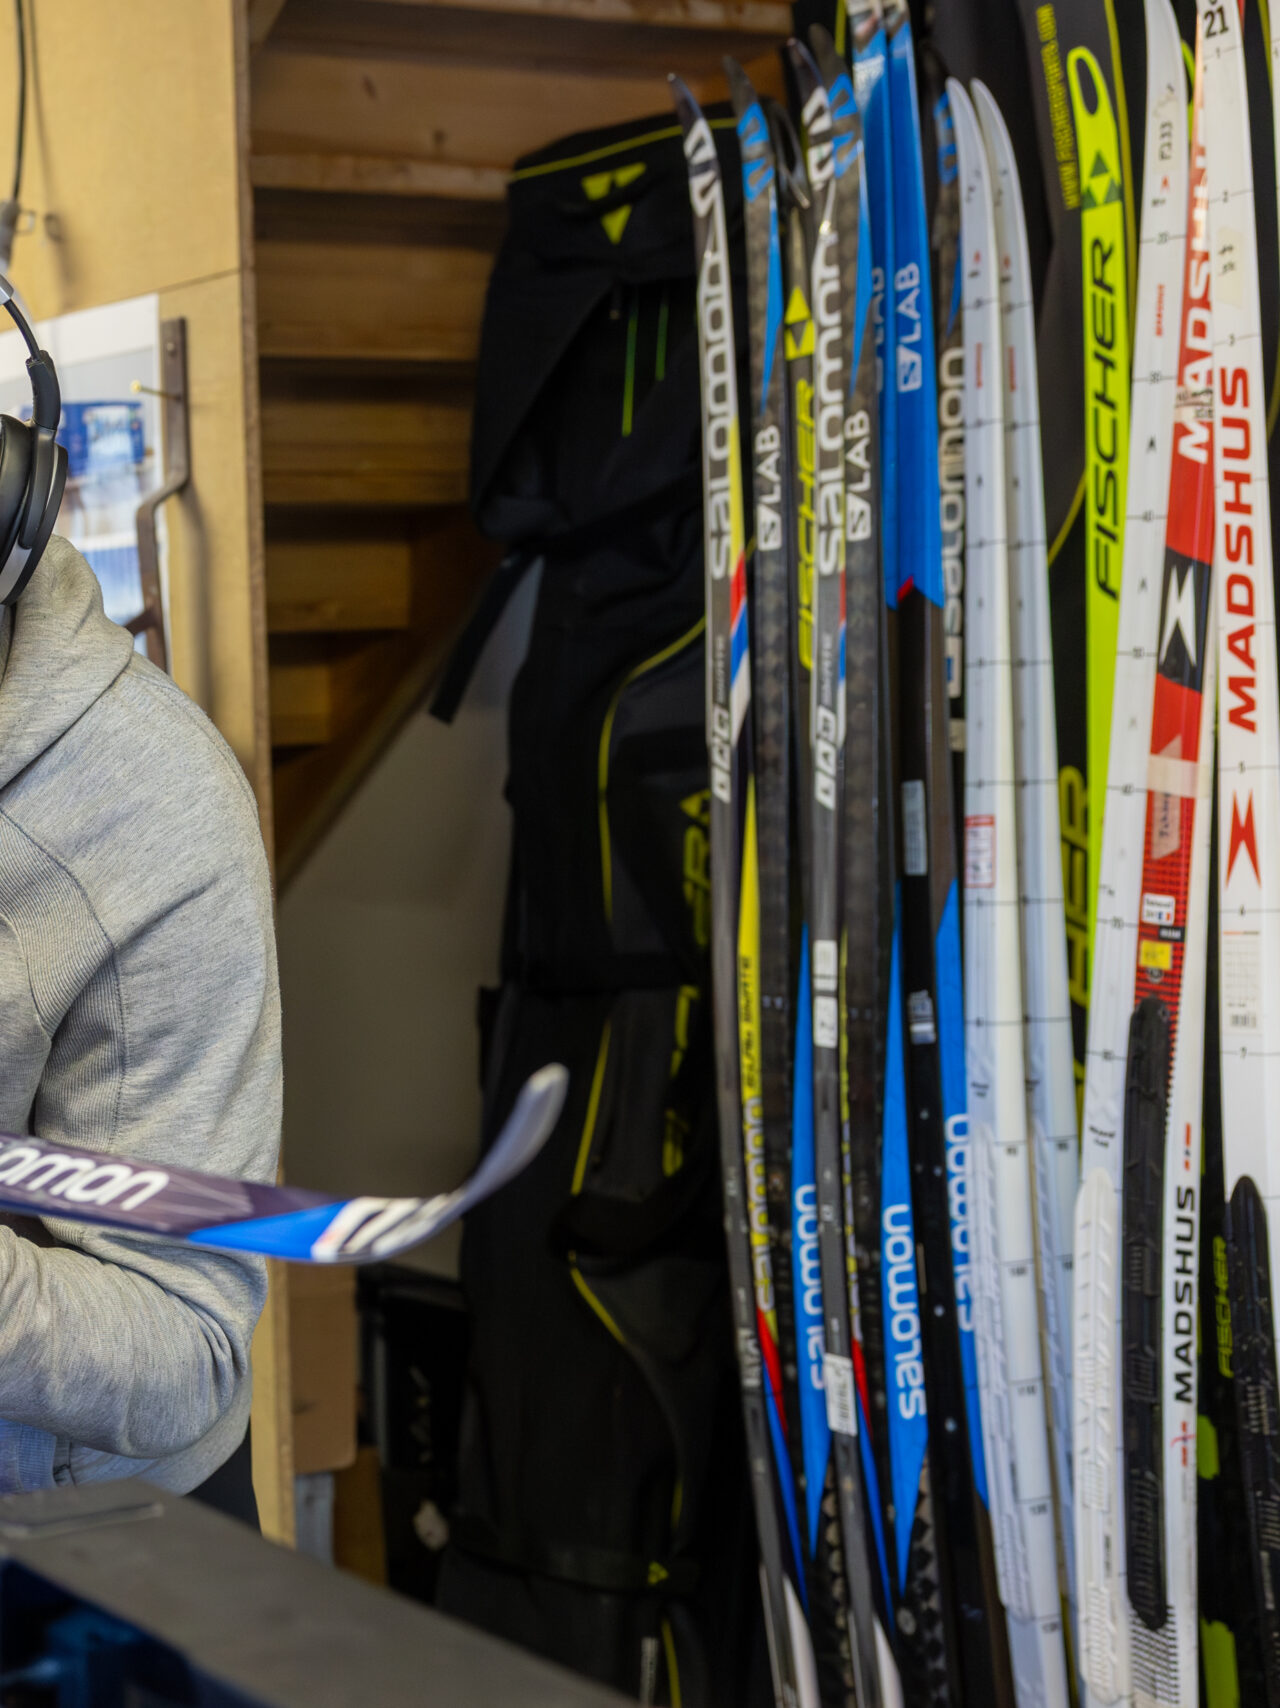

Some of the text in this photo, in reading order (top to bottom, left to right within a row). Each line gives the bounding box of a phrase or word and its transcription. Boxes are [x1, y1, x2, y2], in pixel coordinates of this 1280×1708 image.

[1092, 236, 1118, 601] FISCHER
[1220, 367, 1258, 734] MADSHUS
[1174, 1185, 1195, 1405] MADSHUS
[1212, 1236, 1235, 1379] FISCHER
